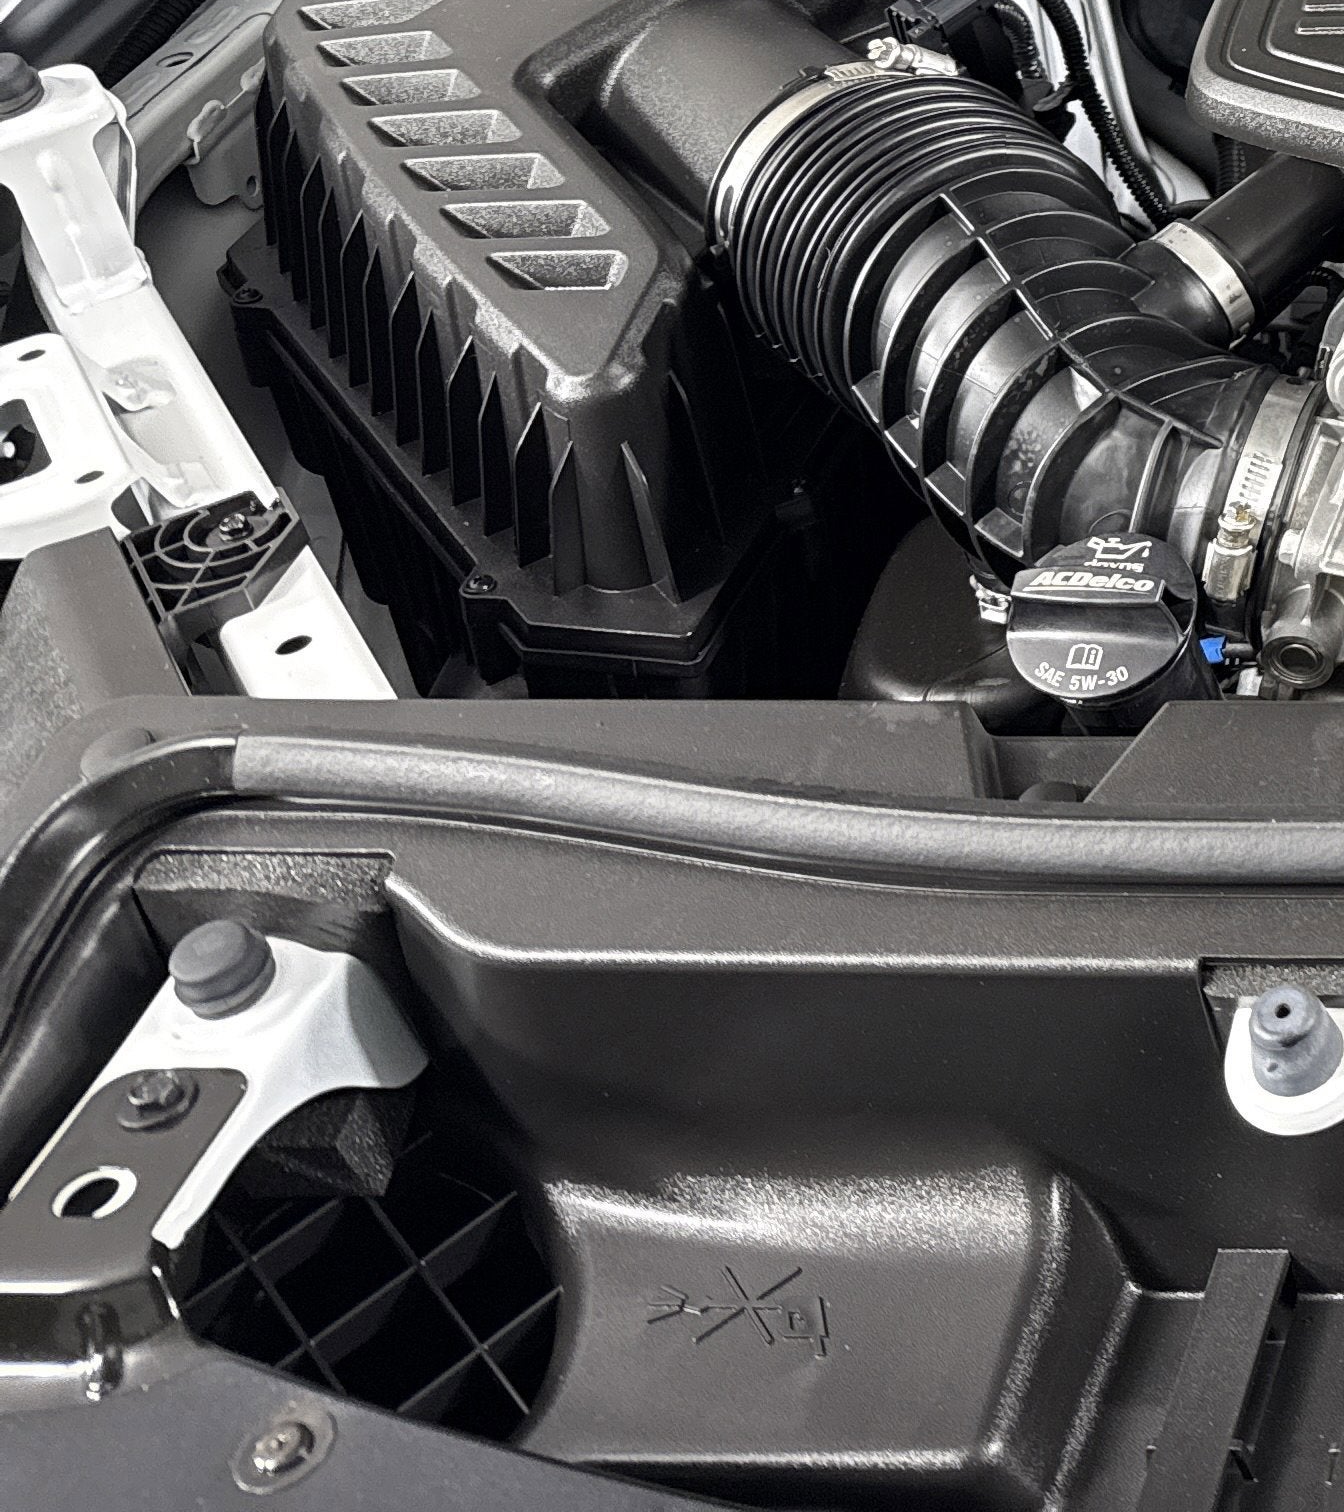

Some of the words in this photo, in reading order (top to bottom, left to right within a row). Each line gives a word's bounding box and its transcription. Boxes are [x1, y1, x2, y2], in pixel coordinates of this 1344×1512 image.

[1029, 571, 1155, 591] ACDelco
[1034, 661, 1066, 687] SAE
[1068, 665, 1129, 690] 5W-30
